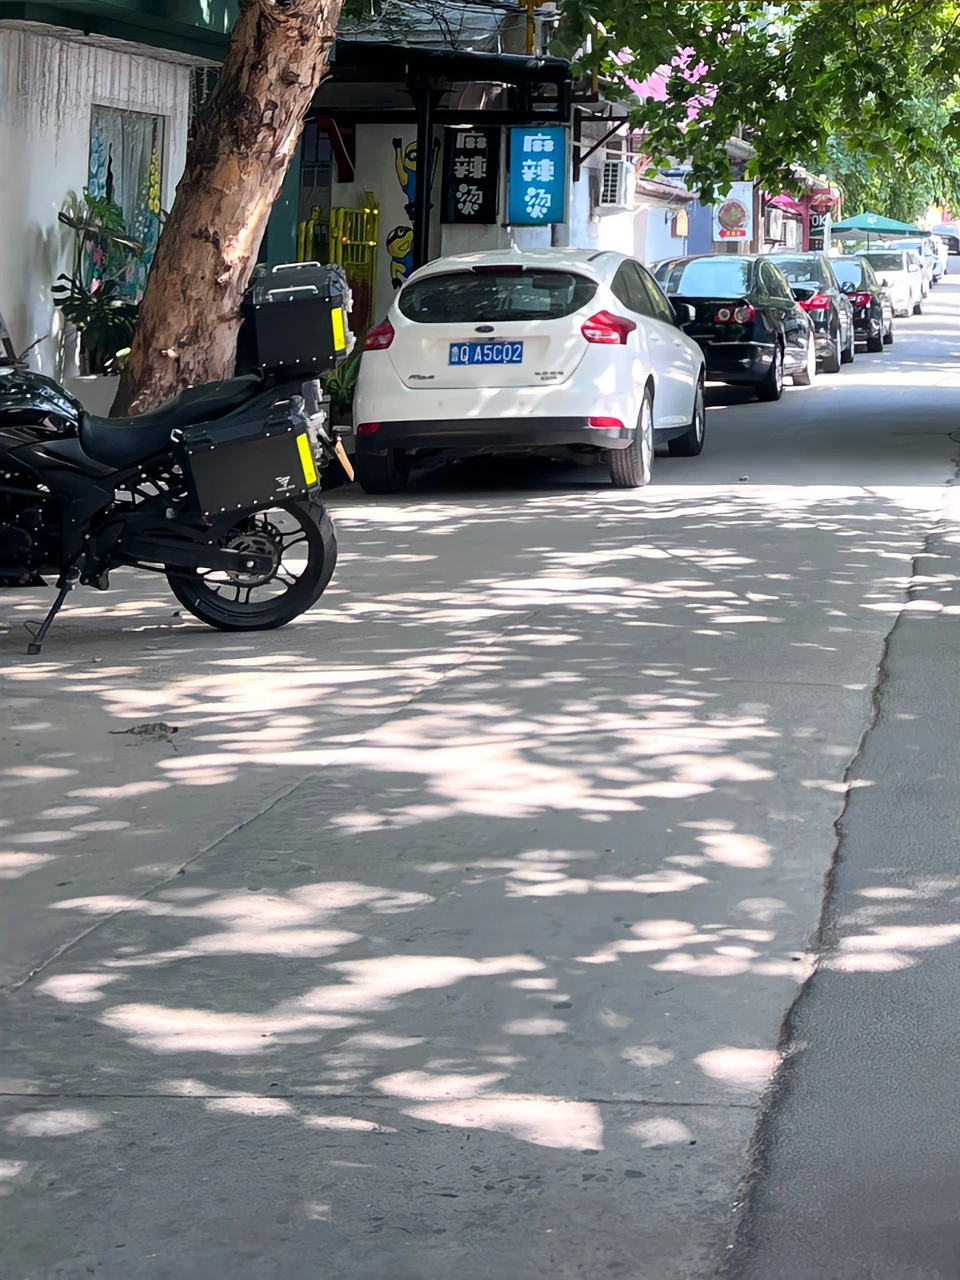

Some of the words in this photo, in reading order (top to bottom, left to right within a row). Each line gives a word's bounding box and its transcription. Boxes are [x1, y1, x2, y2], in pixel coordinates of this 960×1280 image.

[454, 130, 488, 216] 麻辣烫
[521, 132, 555, 219] 麻辣烫
